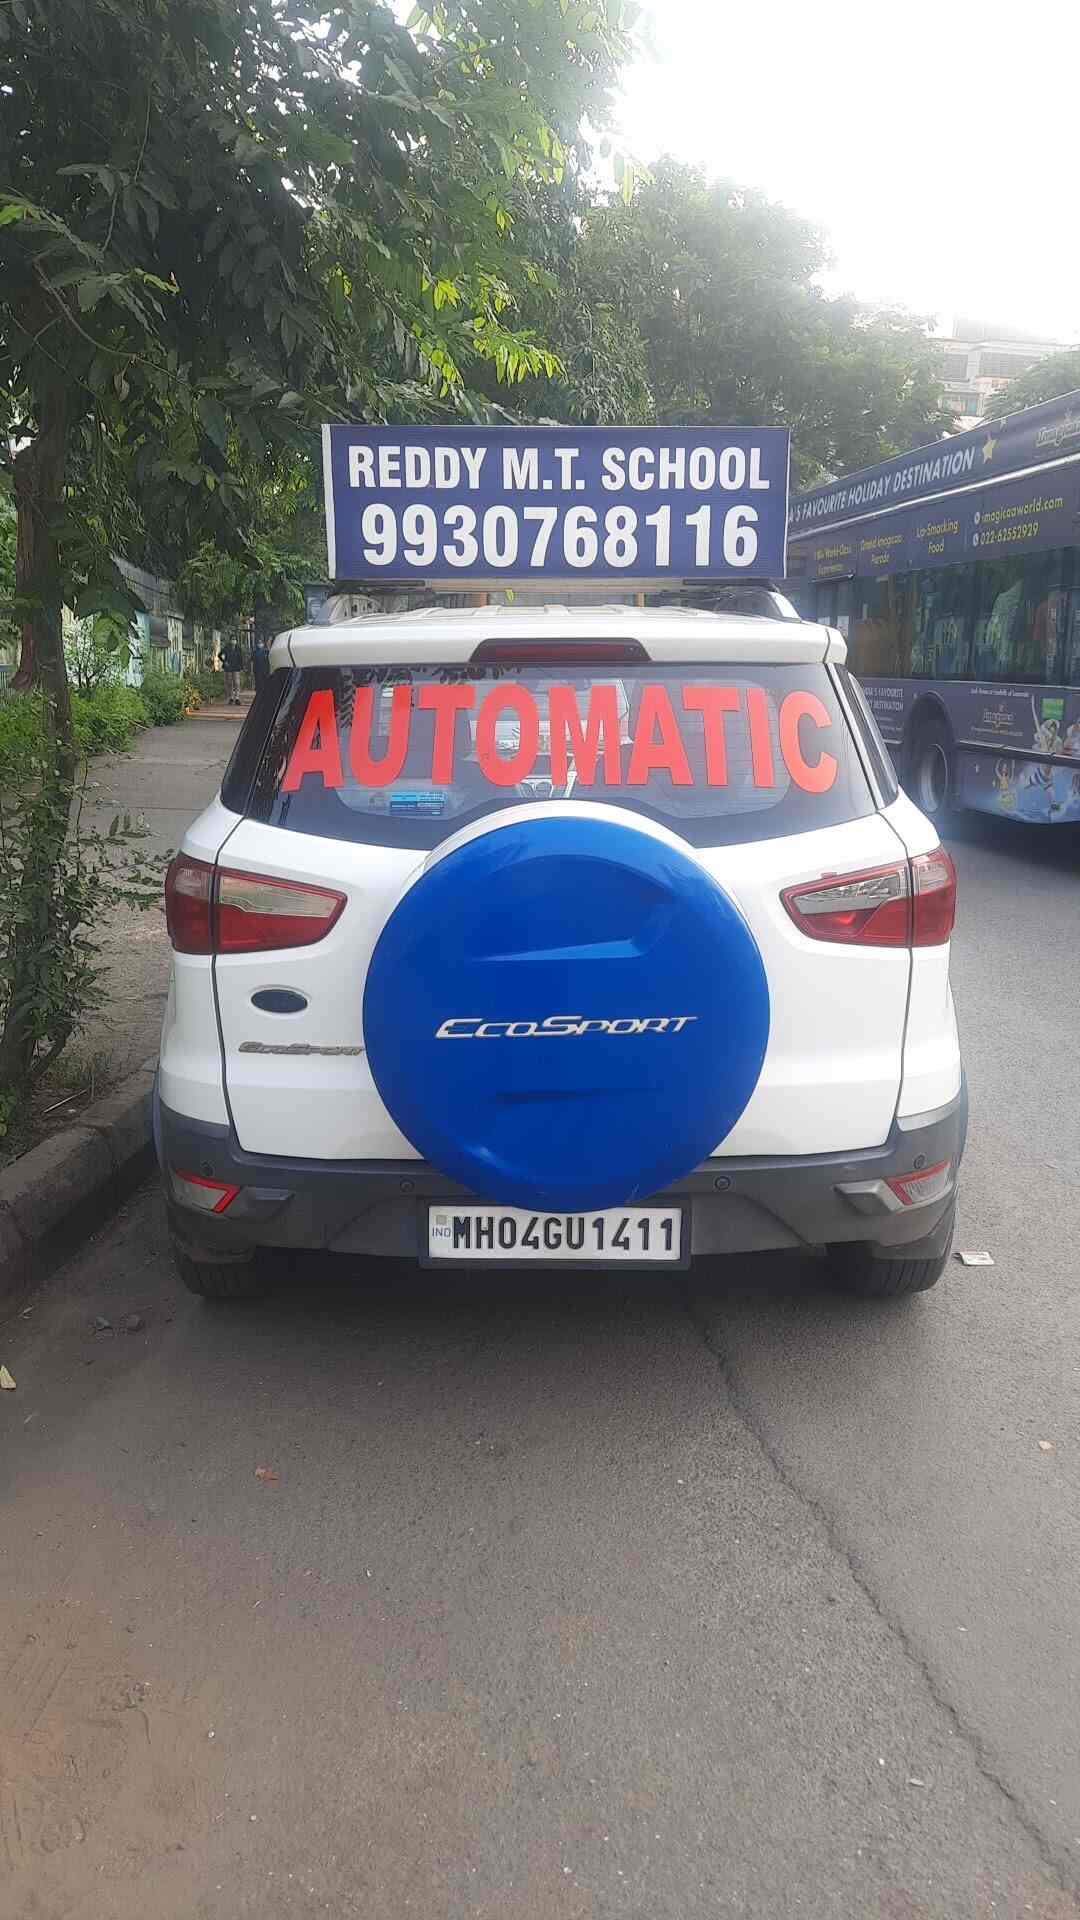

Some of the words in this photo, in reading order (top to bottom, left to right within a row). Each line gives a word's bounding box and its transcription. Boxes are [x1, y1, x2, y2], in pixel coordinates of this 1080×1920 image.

[348, 445, 487, 489] REDDY
[502, 446, 585, 490] M.T.
[601, 446, 770, 490] SCHOOL
[802, 490, 848, 519] FAVOURITE
[848, 472, 893, 507] HOLIDAY
[893, 446, 976, 493] DESTINATION
[981, 496, 1064, 525] imagicaaworld.com
[361, 503, 760, 568] 9930768116
[928, 539, 945, 554] Food
[281, 685, 839, 794] AUTOMATIC
[432, 1227, 451, 1238] IND
[453, 1215, 673, 1250] MH04GU1411
